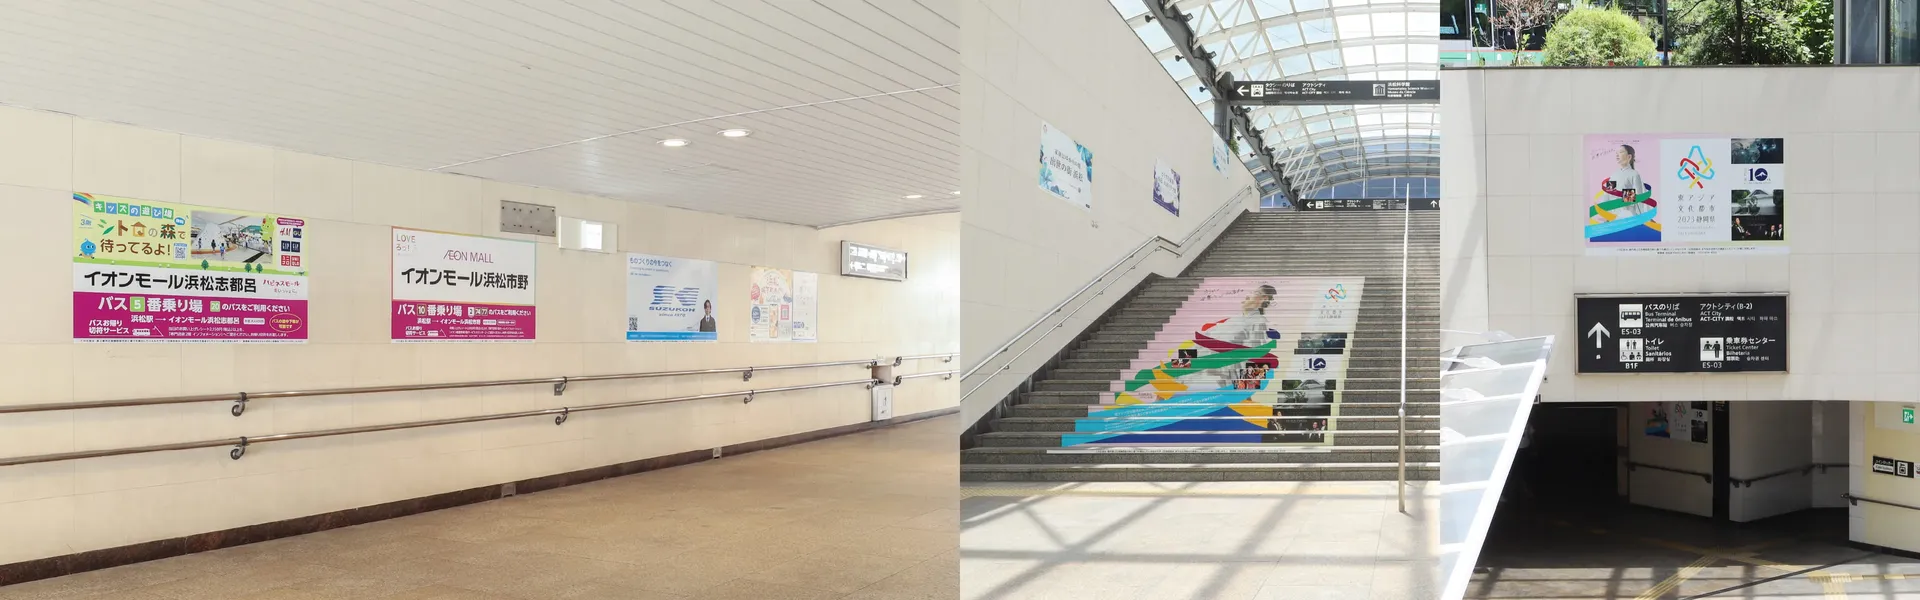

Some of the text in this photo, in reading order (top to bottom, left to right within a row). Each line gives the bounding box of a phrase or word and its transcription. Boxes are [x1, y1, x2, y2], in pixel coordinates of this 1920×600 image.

[94, 202, 173, 218] キッズの遊び場
[397, 234, 416, 243] LOVE
[470, 252, 493, 263] MALL
[84, 272, 256, 293] イオンモール浜松志都呂
[402, 268, 528, 290] イオンモール浜松市野
